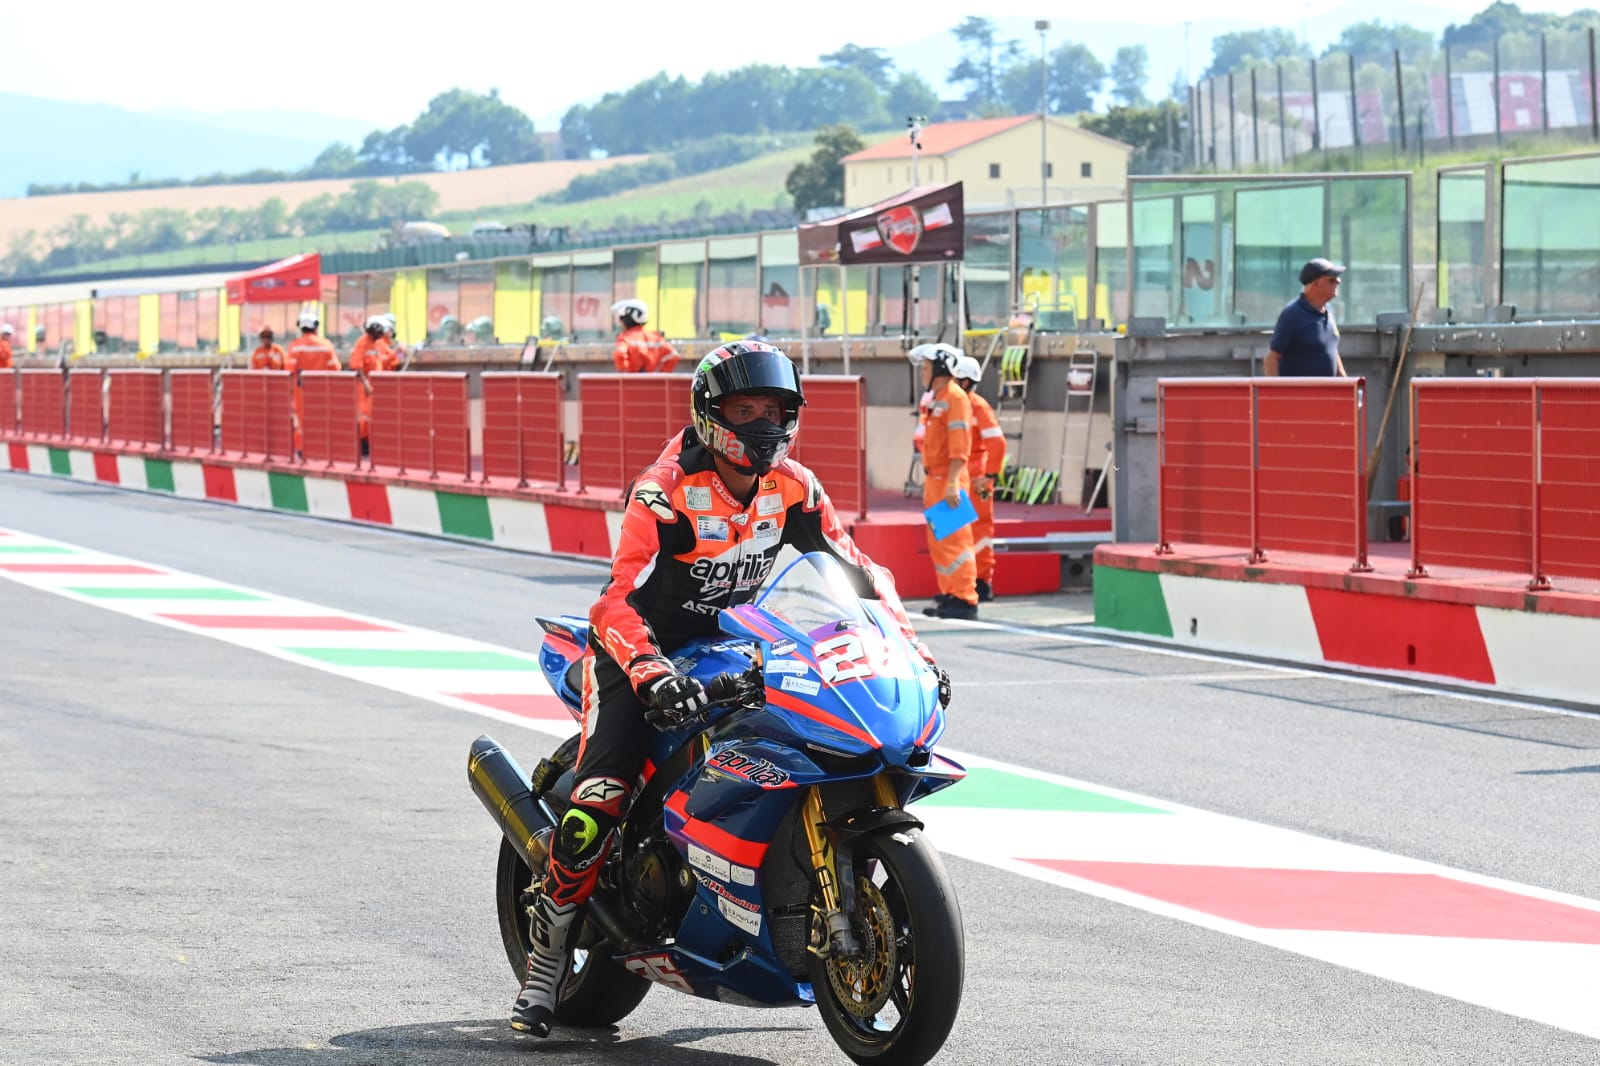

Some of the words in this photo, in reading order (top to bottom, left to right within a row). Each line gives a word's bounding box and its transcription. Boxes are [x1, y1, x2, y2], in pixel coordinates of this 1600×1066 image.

[690, 553, 774, 586] aprilia
[682, 599, 721, 617] AST
[714, 749, 787, 786] aprilia
